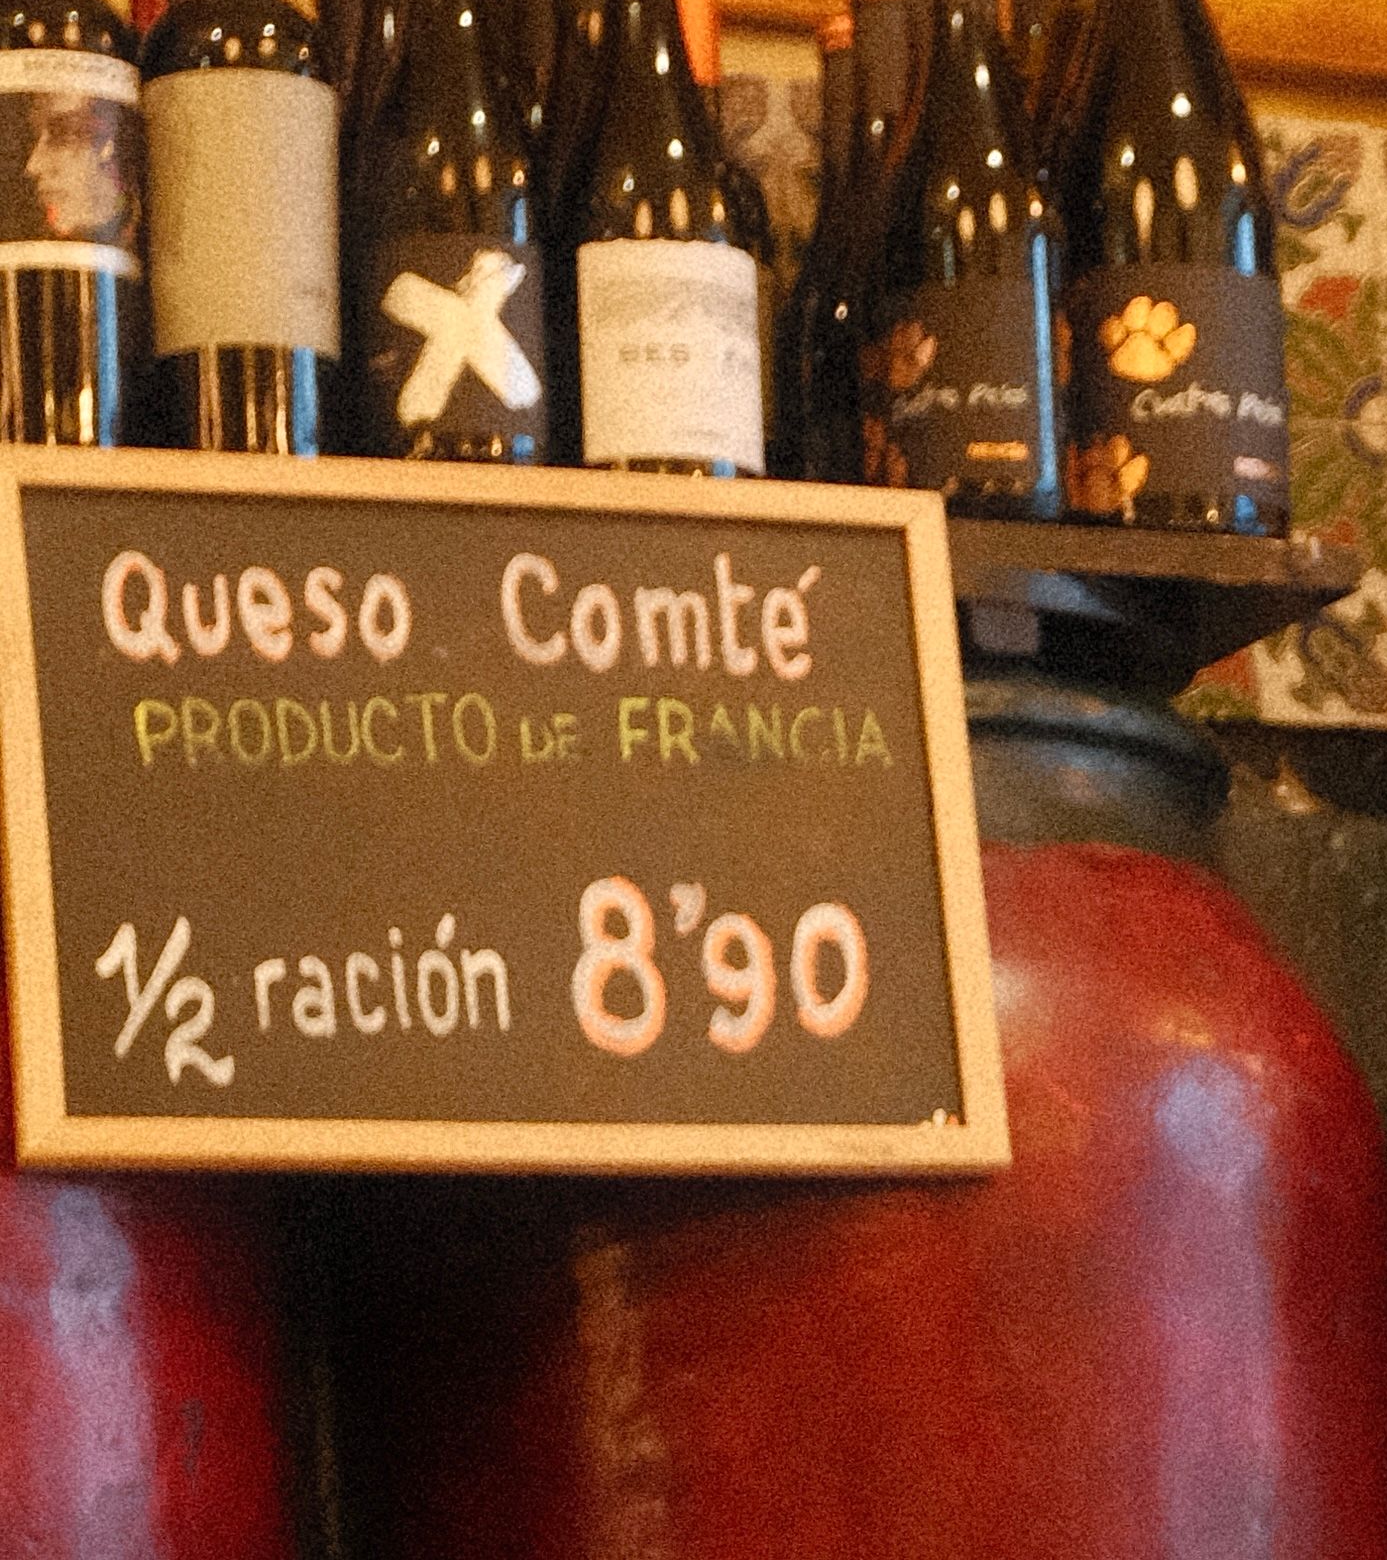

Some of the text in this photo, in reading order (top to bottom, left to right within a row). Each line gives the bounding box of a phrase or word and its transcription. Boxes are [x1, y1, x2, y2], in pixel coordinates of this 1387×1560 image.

[101, 550, 821, 681] Queso Comté
[133, 692, 894, 769] PRODUCTO DE FRANCIA
[254, 912, 512, 1035] ración
